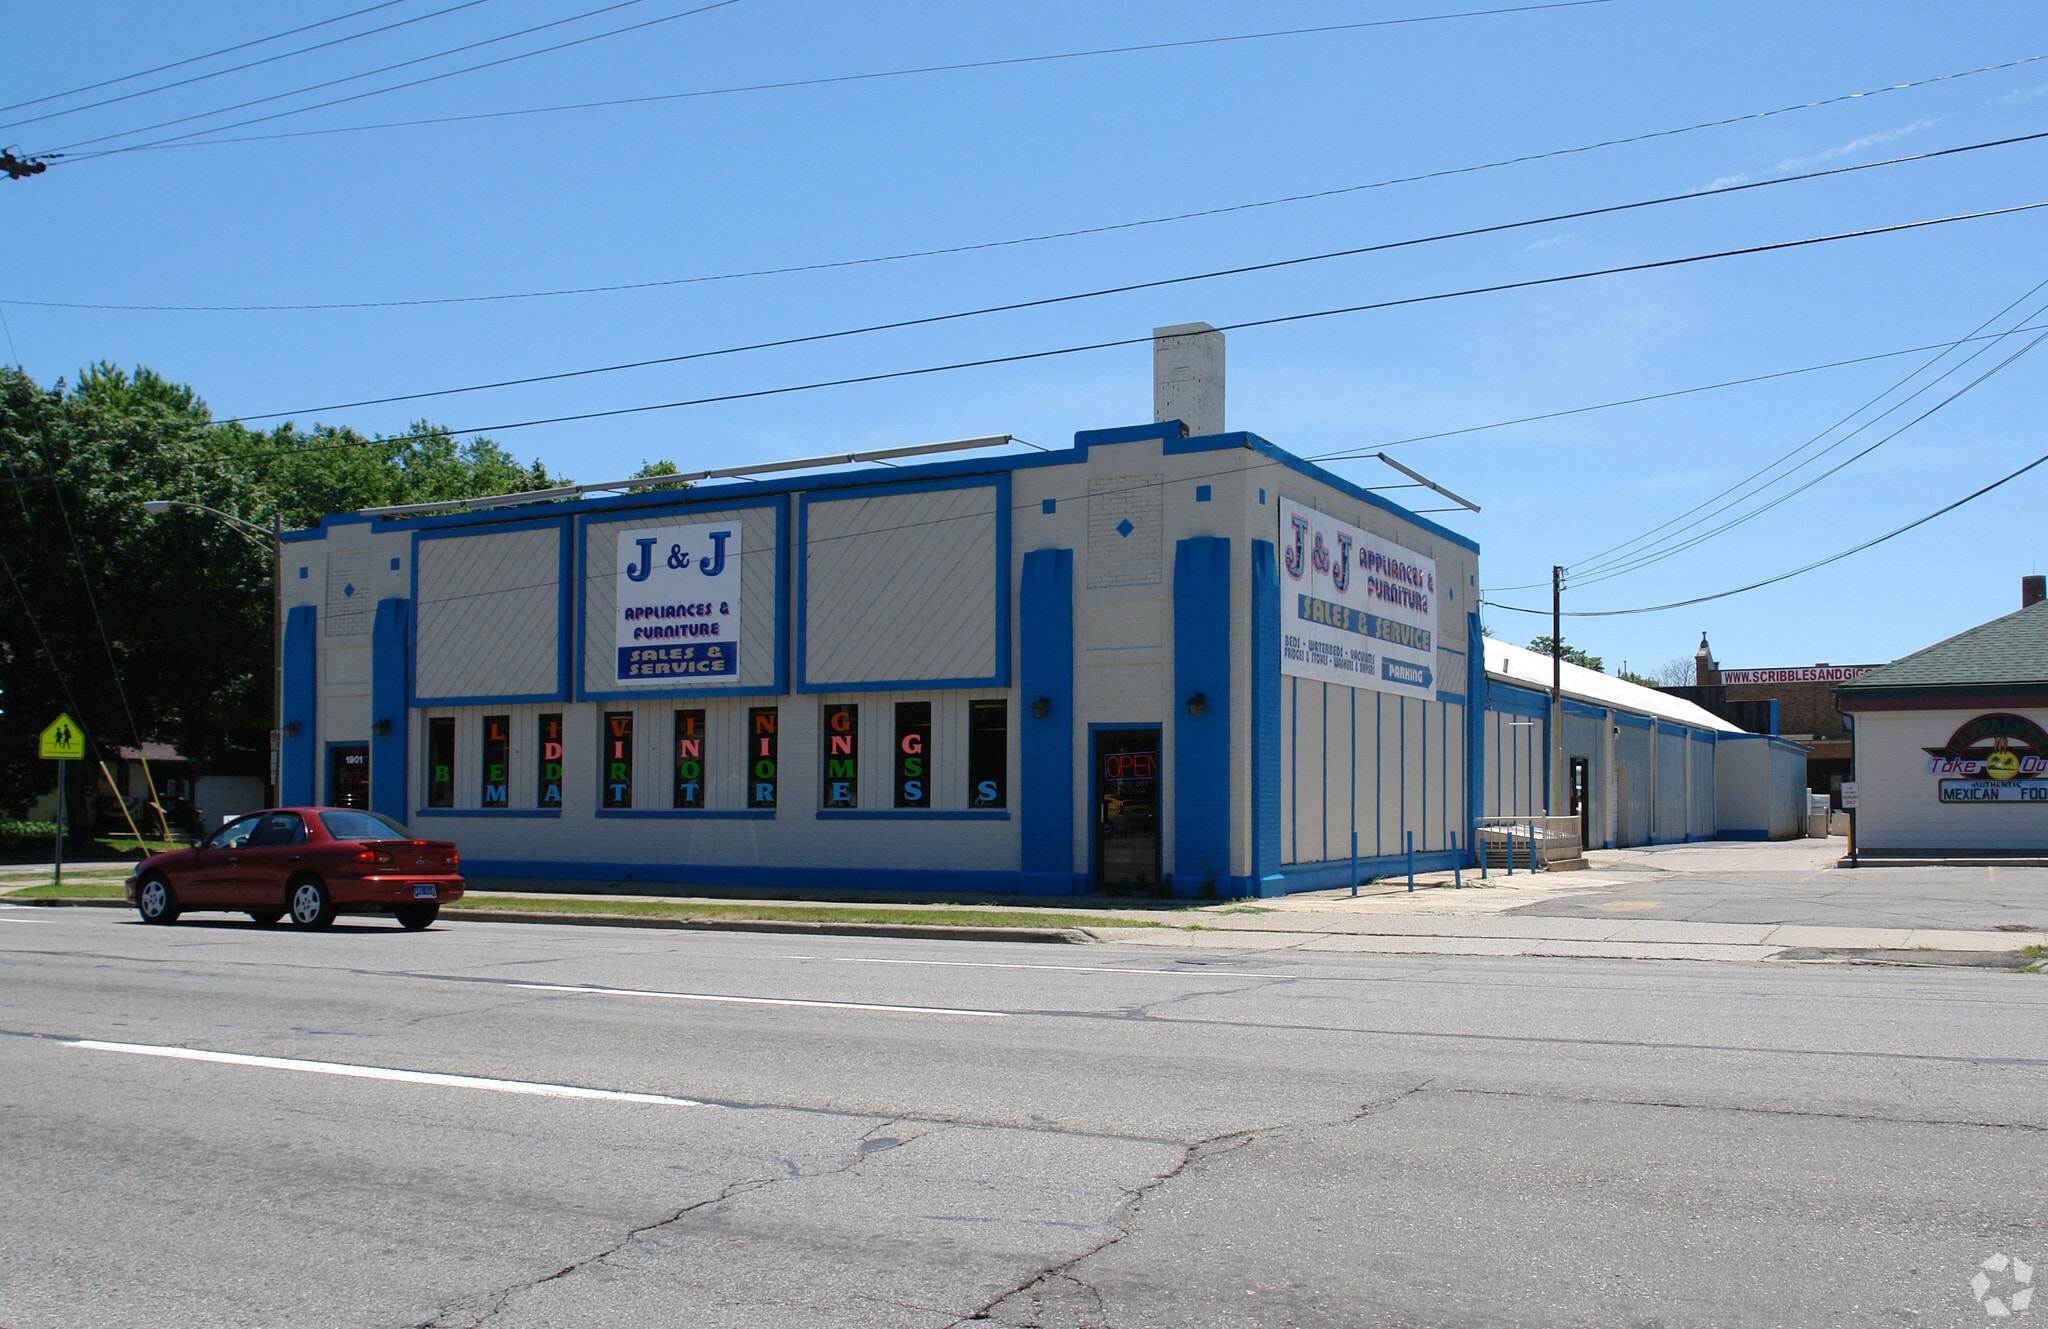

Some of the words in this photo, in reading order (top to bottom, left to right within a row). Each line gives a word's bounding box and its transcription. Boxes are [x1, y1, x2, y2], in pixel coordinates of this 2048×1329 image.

[627, 538, 657, 582] J
[667, 544, 690, 569] &
[700, 531, 731, 576] J
[1359, 547, 1424, 590] APPLIANCES
[1427, 573, 1434, 594] &
[1367, 576, 1428, 615] FURNITURE
[624, 603, 712, 621] APPLIANCES
[719, 602, 730, 617] &
[634, 622, 720, 640] FURNITURE
[1303, 598, 1350, 629] SALES
[1357, 615, 1368, 634] &
[1375, 620, 1430, 650] SERVICE
[630, 647, 694, 662] SALES
[707, 646, 722, 658] &
[1284, 647, 1304, 661] FRIDGES
[1311, 651, 1328, 666] STOVES
[1285, 635, 1300, 648] BEDS
[1308, 640, 1343, 657] WATERBEDS
[1350, 649, 1375, 664] VACUUMS
[629, 660, 725, 675] SERVICE
[1389, 663, 1423, 683] PARKING
[1724, 669, 1872, 683] WWW.SCRIBBLESANDGIG
[345, 755, 363, 764] 1901
[1106, 754, 1156, 778] OPEN
[1931, 758, 1976, 773] Take
[1943, 788, 1998, 800] MEXICAN
